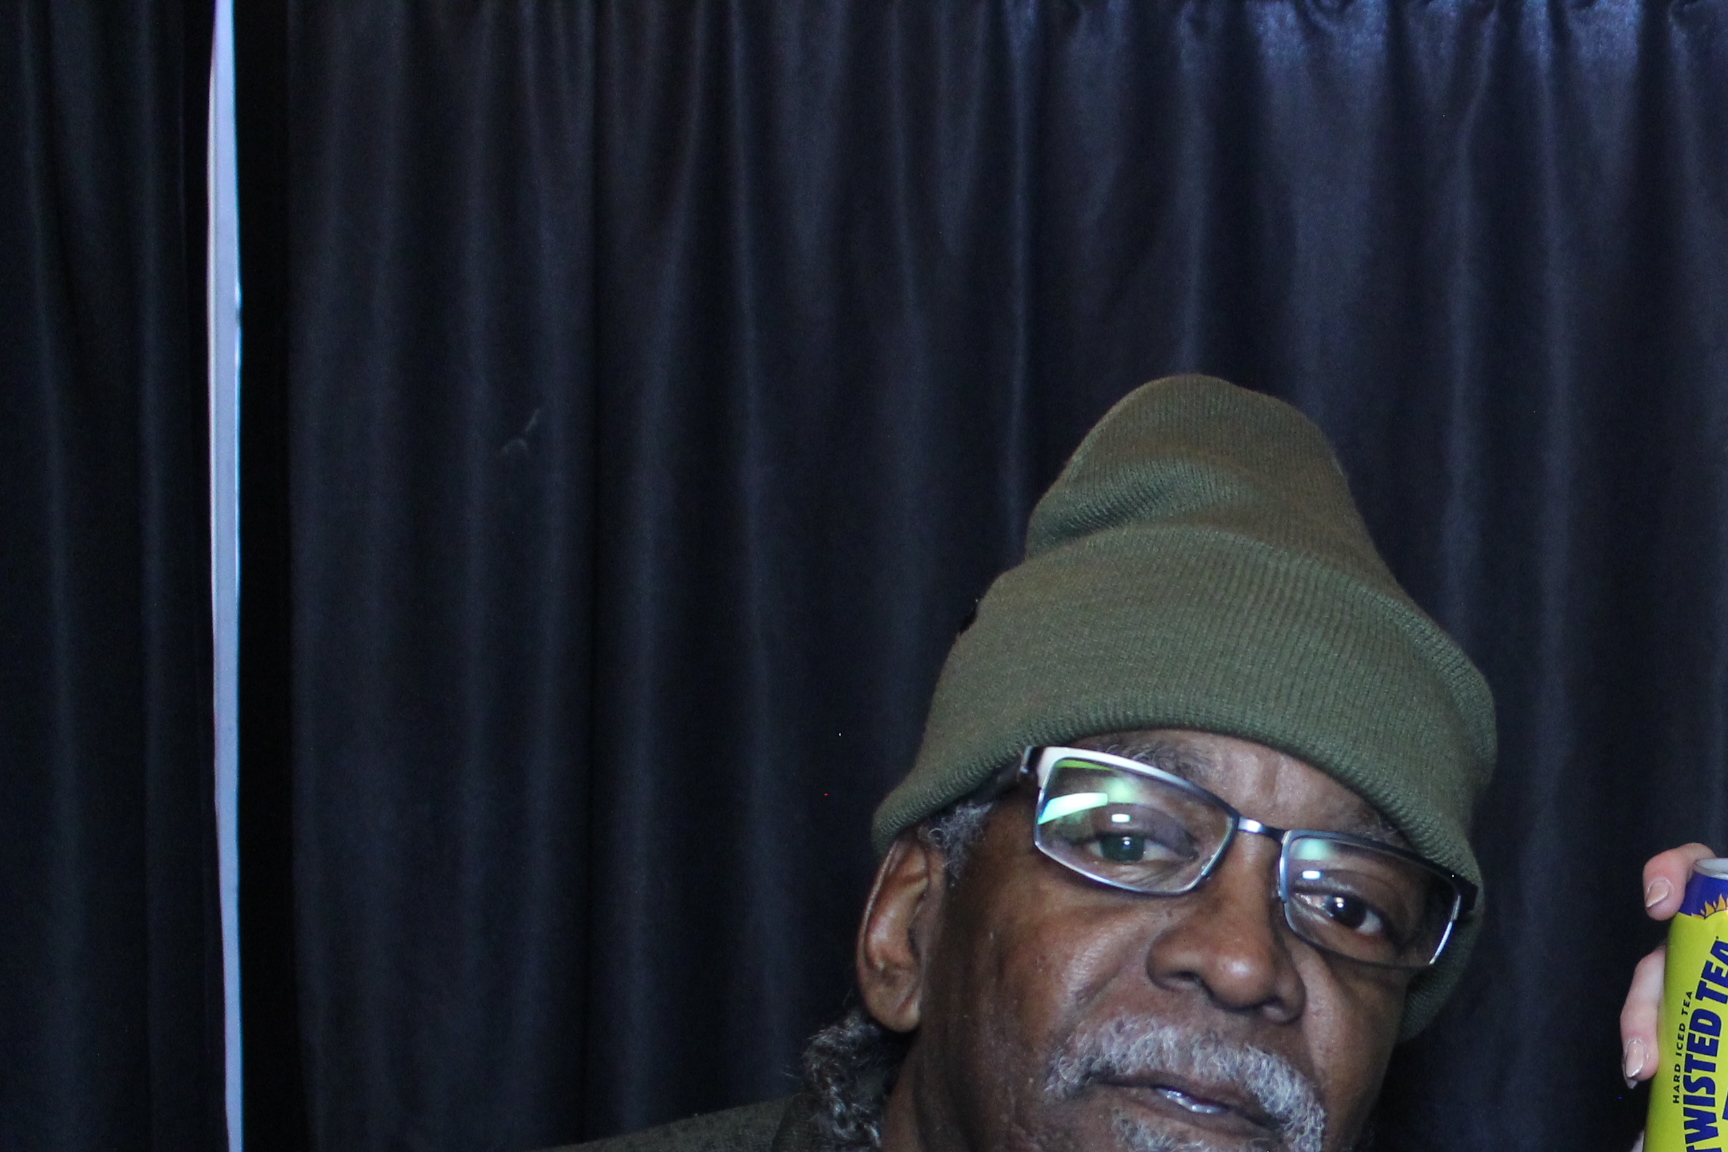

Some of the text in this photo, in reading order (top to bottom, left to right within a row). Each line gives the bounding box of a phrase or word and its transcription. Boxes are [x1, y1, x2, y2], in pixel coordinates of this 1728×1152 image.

[1672, 991, 1693, 1104] HARD ICED TEA
